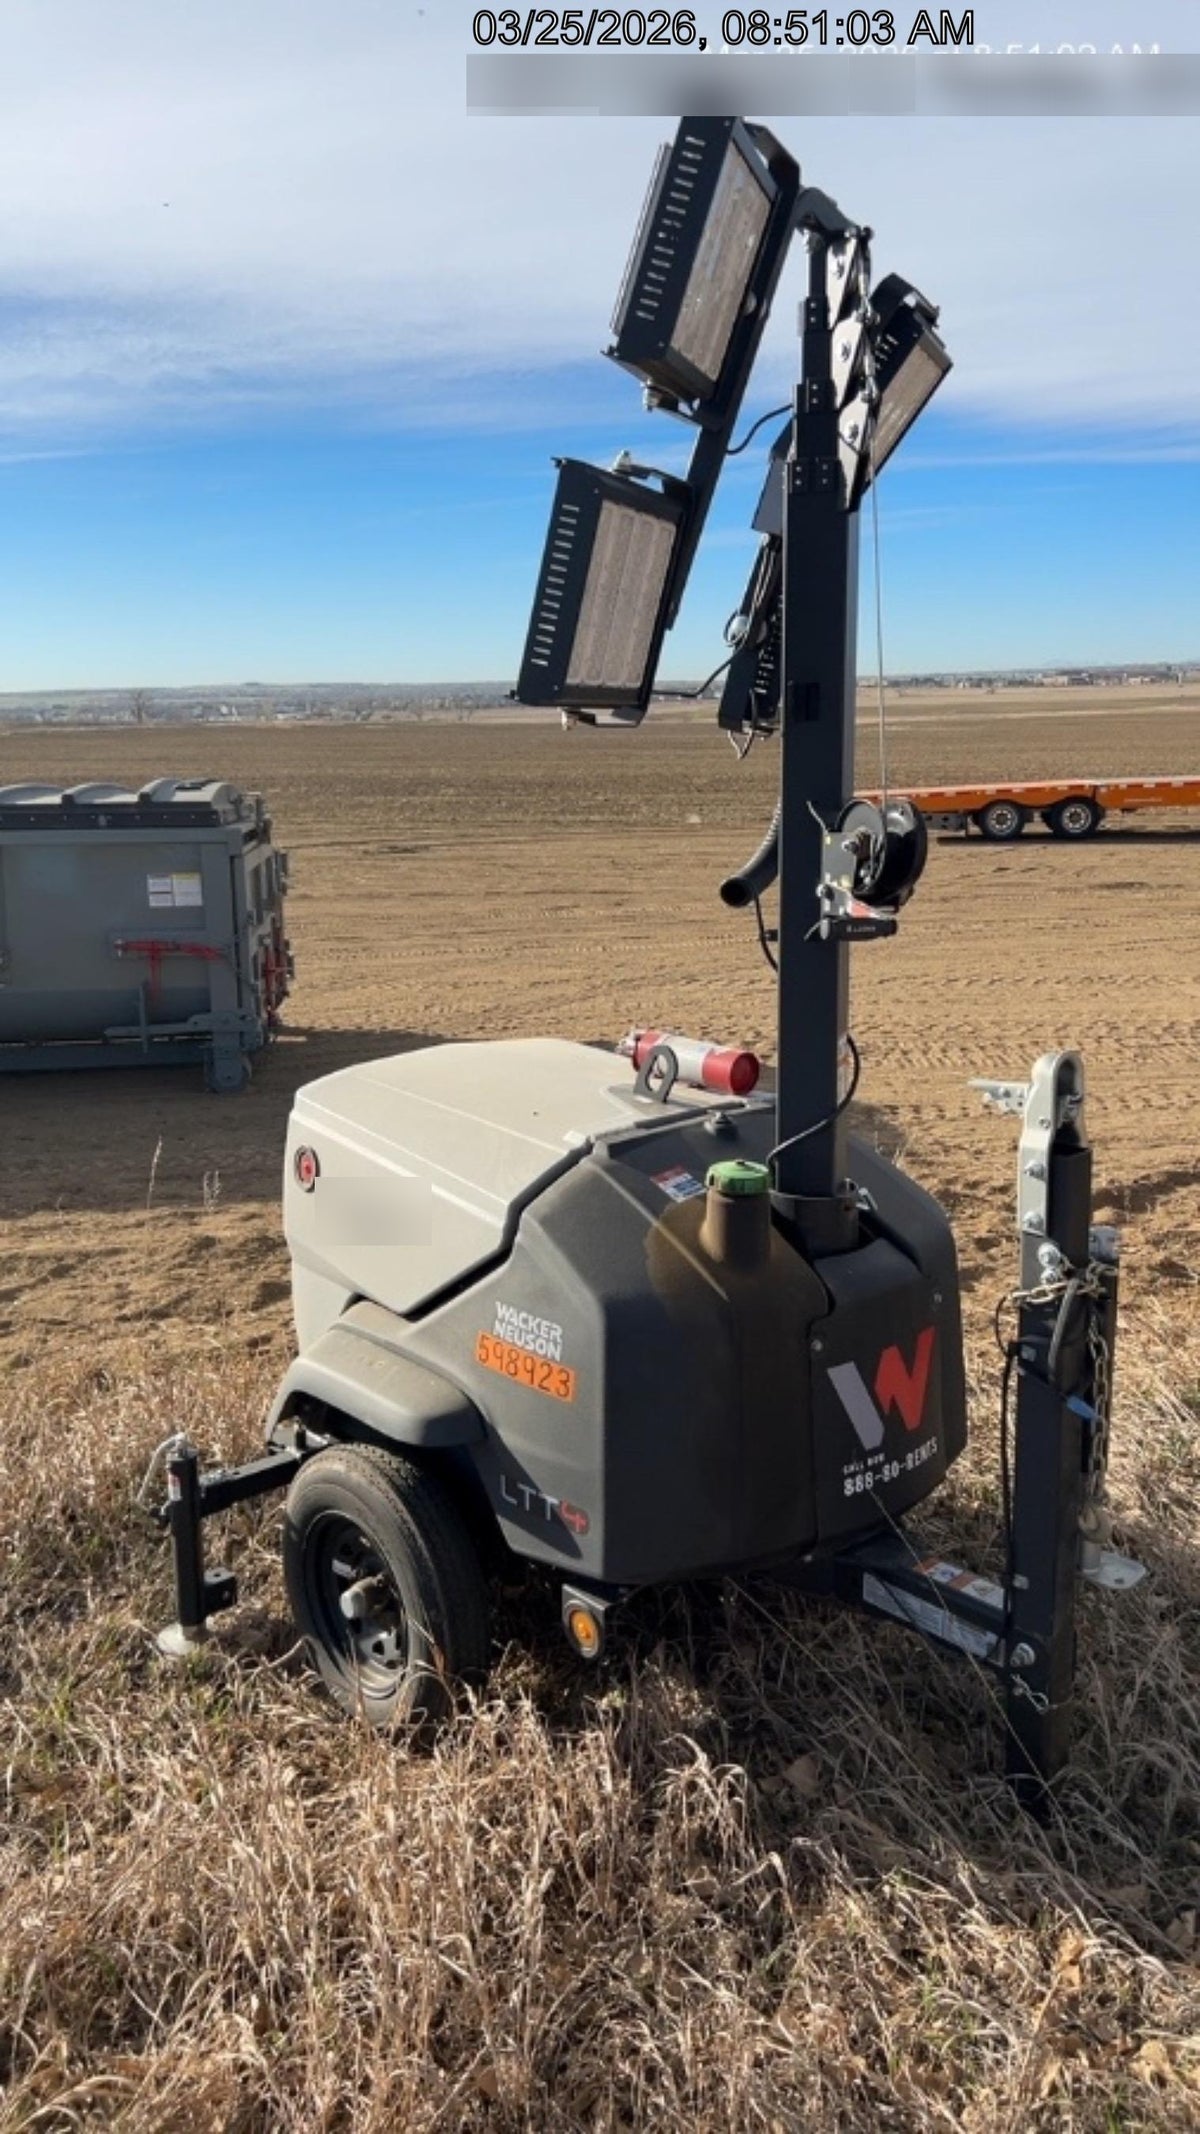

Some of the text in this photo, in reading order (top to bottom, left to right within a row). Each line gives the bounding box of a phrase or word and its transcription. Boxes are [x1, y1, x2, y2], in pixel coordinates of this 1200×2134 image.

[492, 1319, 563, 1363] NEUSON
[494, 1300, 563, 1344] WACKER
[478, 1333, 571, 1399] 598923
[500, 1474, 588, 1534] LTT4
